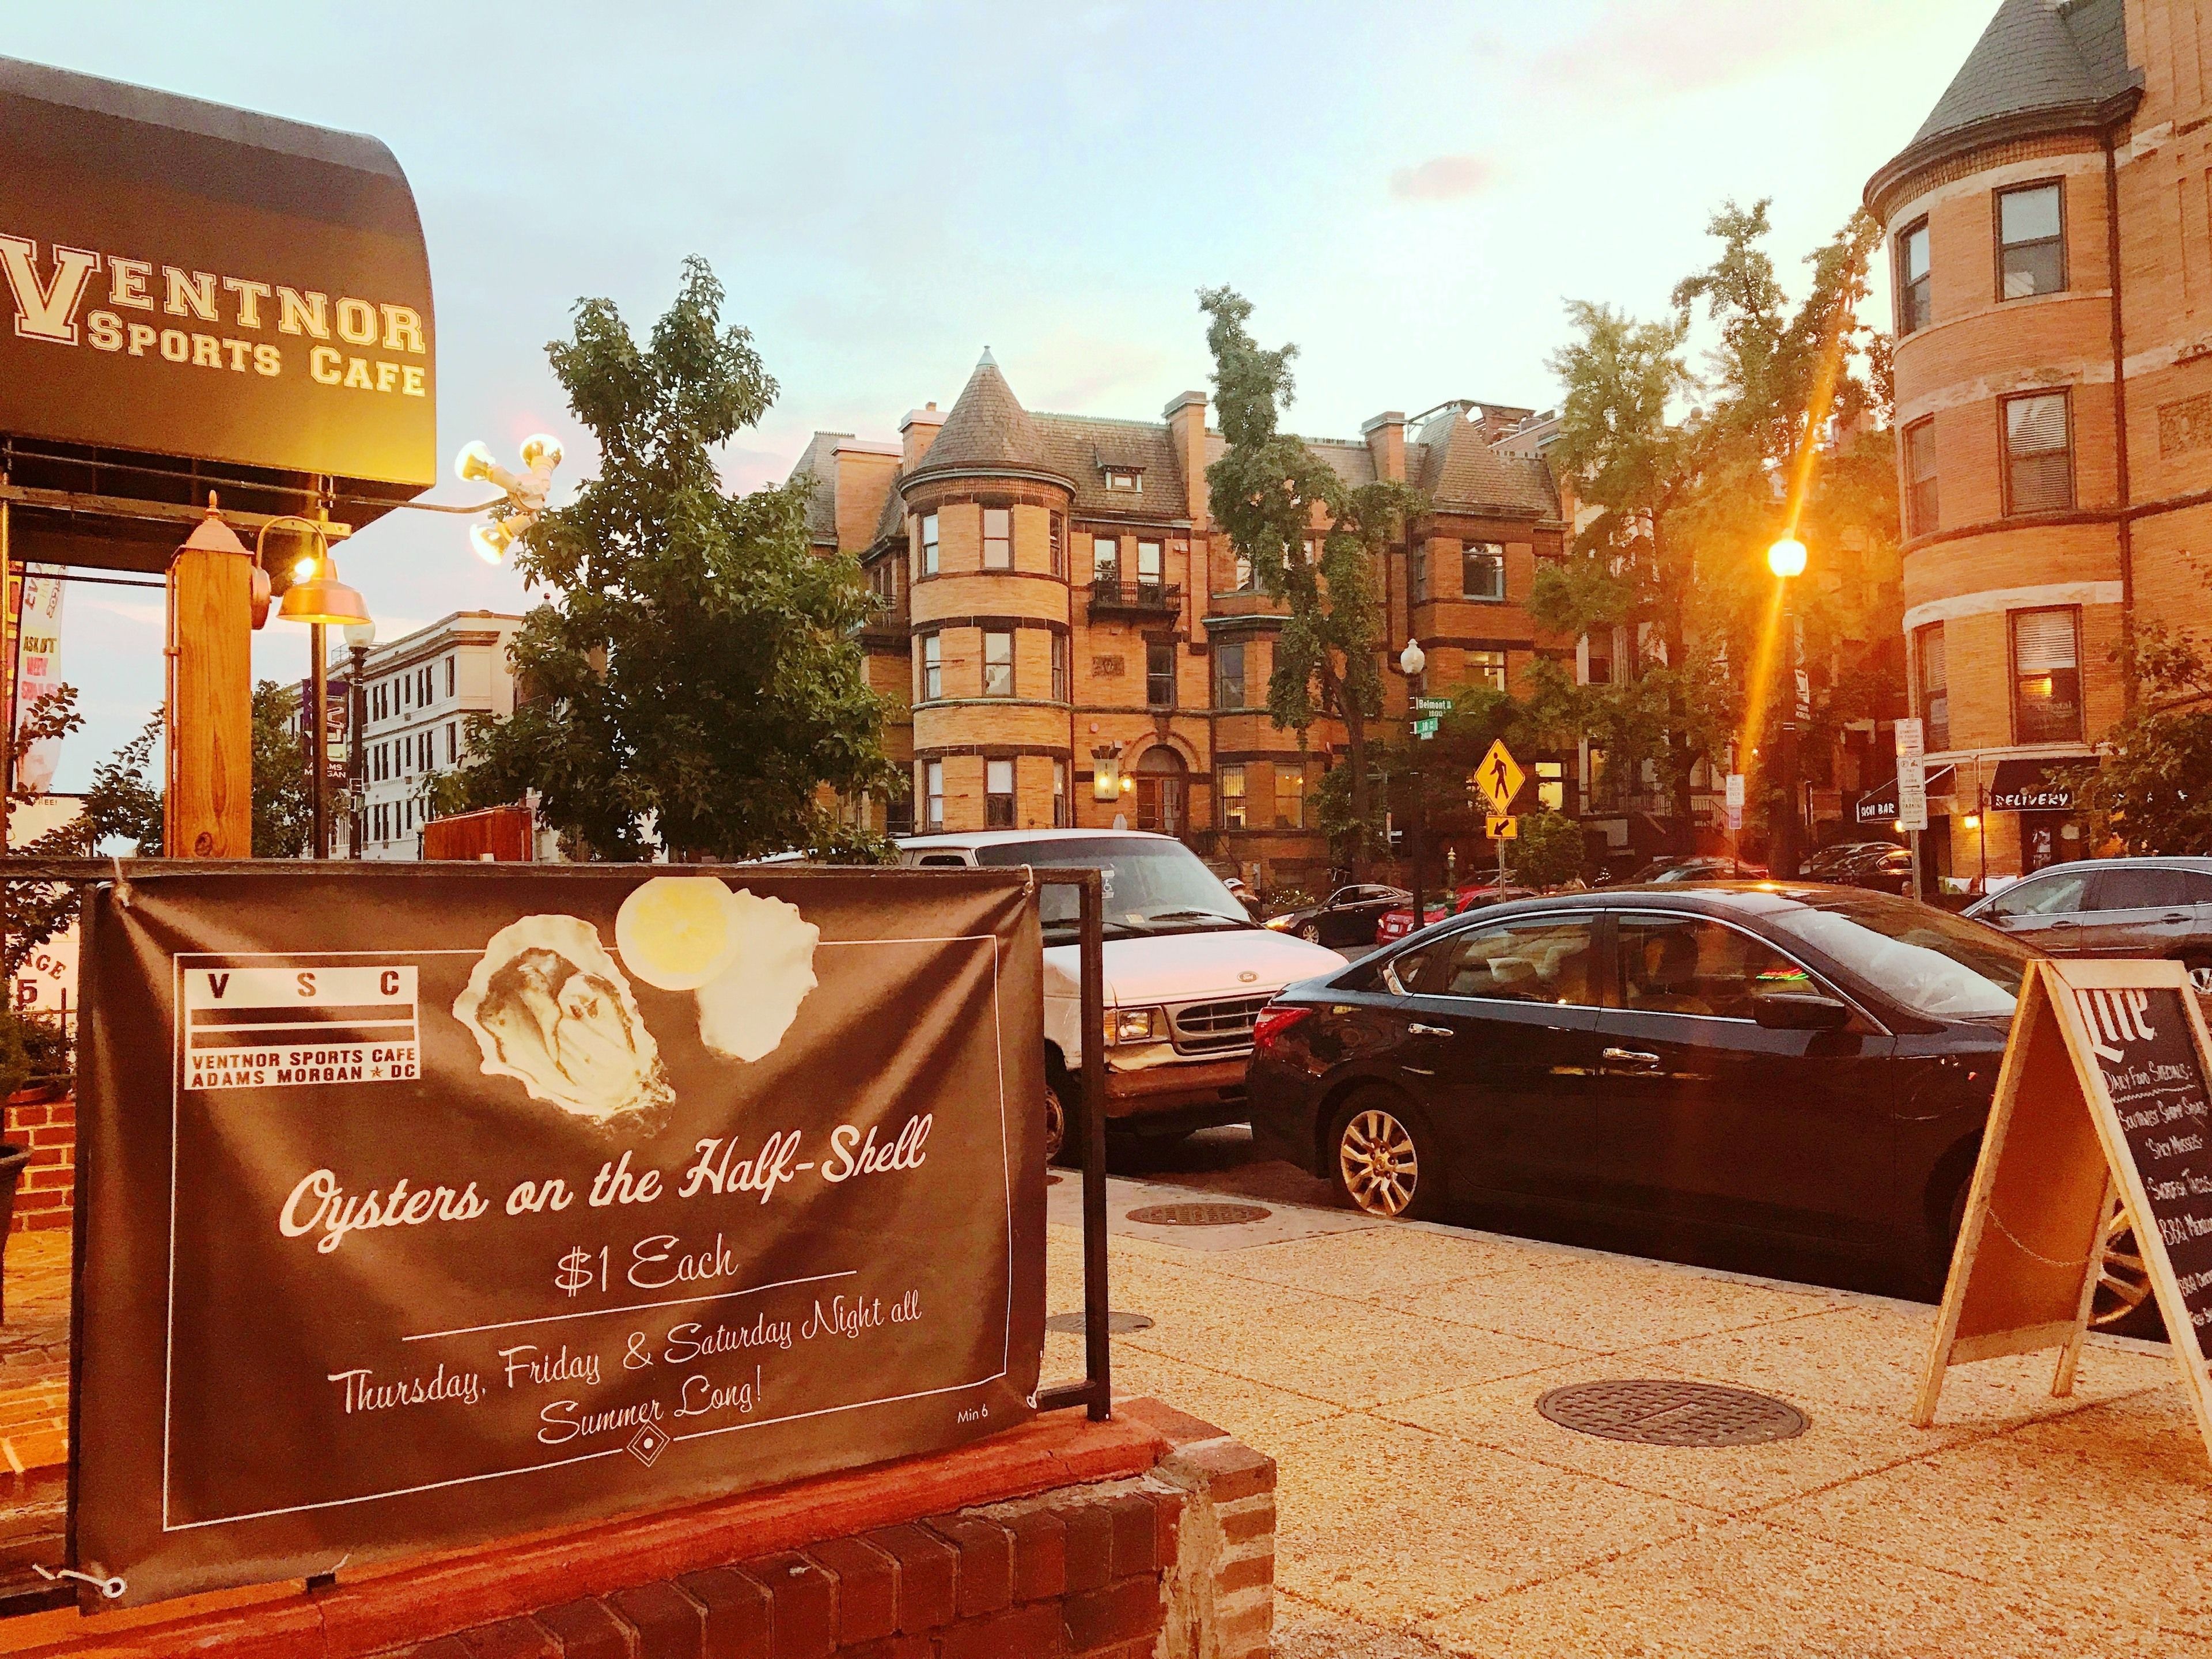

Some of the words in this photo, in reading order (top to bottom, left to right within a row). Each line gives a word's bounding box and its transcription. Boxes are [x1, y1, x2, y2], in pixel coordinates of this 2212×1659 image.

[0, 234, 426, 355] VENTNOR
[87, 309, 281, 377] SPORTS
[309, 345, 425, 397] CAFE
[1419, 699, 1446, 710] Belmont
[1878, 802, 1895, 815] BAR
[1995, 793, 2069, 806] DELIVERY
[207, 974, 229, 998] V
[297, 972, 317, 997] S
[380, 971, 399, 996] C
[192, 1053, 280, 1070] VENTNOR
[290, 1050, 363, 1066] SPORTS
[372, 1048, 415, 1063] CAFE
[191, 1069, 264, 1088] ADAMS
[277, 1066, 362, 1083] MORGAN
[391, 1065, 415, 1078] DC
[279, 1169, 489, 1253] Oysters
[506, 1179, 574, 1216] on
[588, 1150, 663, 1207] the
[678, 1113, 933, 1205] Half-Shell
[554, 1245, 608, 1298] $1
[627, 1233, 738, 1289] Each
[327, 1363, 486, 1414] Thursday,
[498, 1344, 600, 1388] Friday
[623, 1331, 654, 1370] &
[664, 1312, 792, 1363] Saturday
[801, 1294, 884, 1340] Night
[890, 1289, 922, 1322] all
[537, 1400, 664, 1445] Summer
[673, 1365, 762, 1418] Long!
[957, 1411, 979, 1424] Min
[980, 1406, 988, 1418] 6
